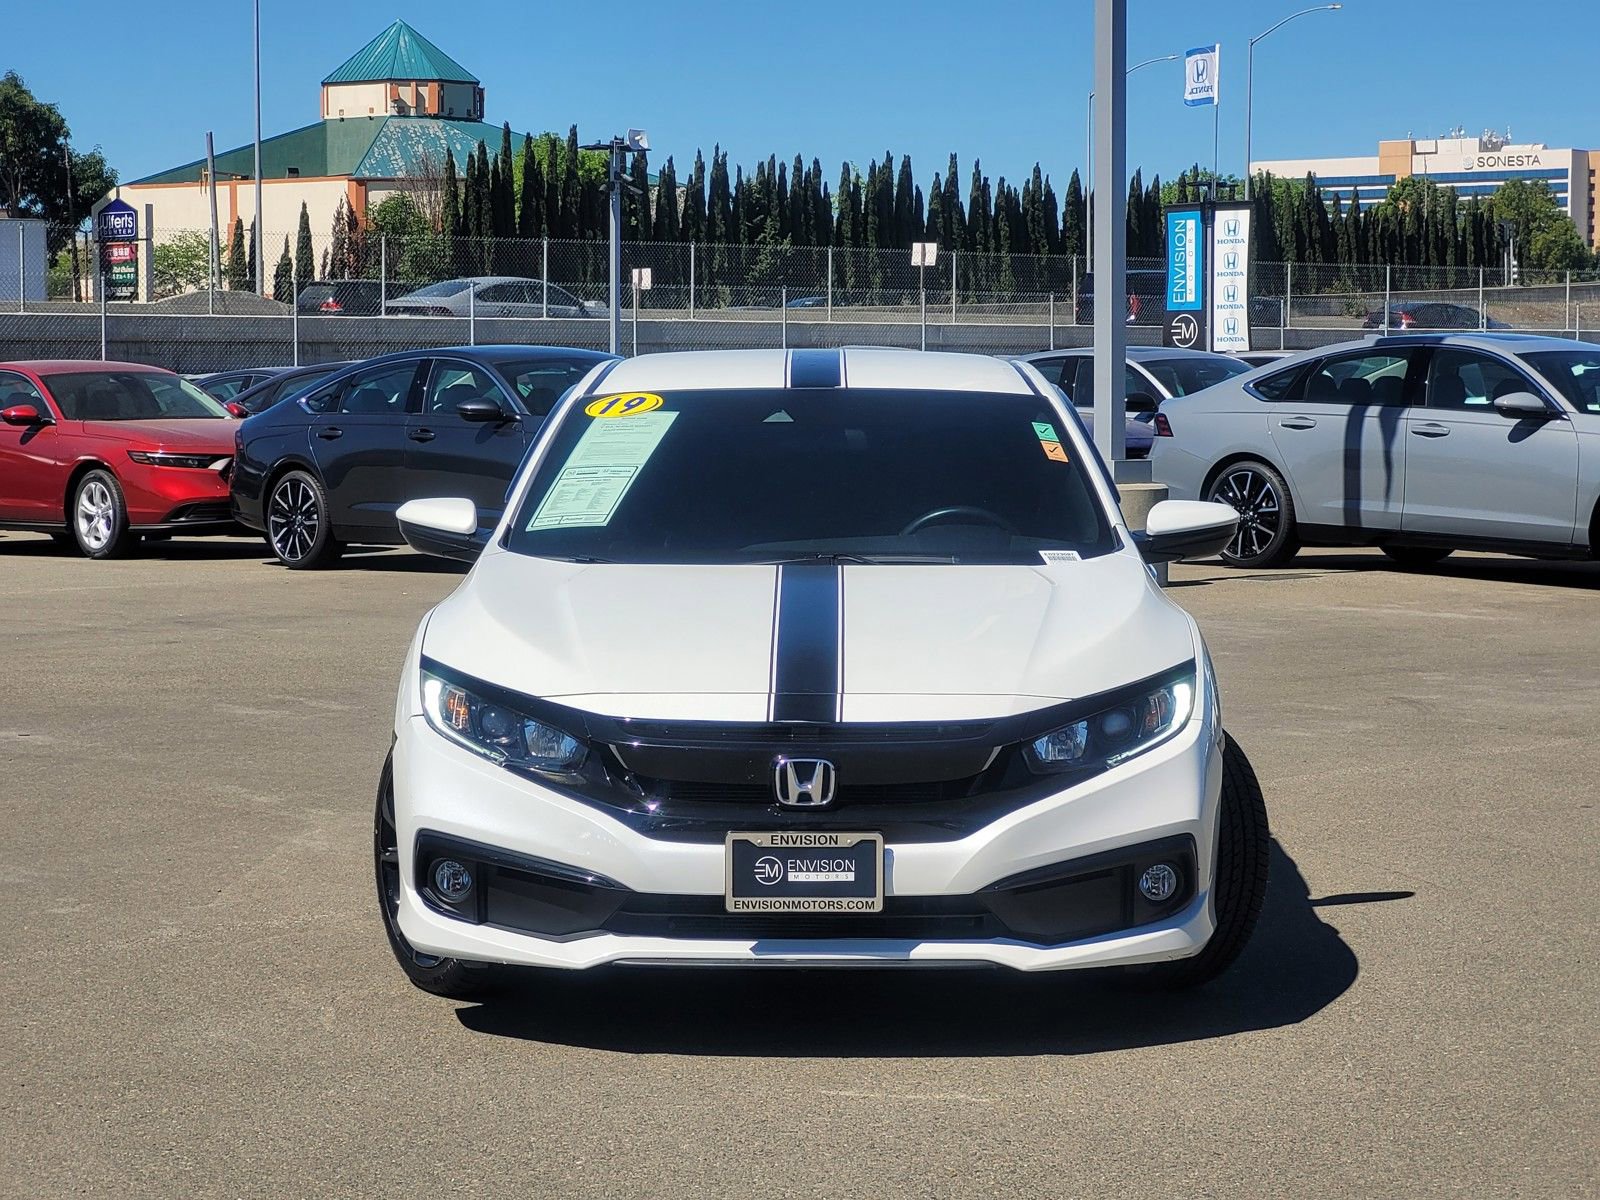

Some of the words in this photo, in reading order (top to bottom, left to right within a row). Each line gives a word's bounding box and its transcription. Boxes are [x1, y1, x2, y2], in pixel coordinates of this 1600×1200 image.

[1477, 154, 1541, 168] SONESTA
[102, 214, 133, 229] Ulferts
[1216, 237, 1246, 245] HONDA
[1173, 219, 1186, 303] ENVISION
[1216, 335, 1246, 343] HONDA
[599, 397, 647, 414] 19
[770, 834, 839, 846] ENVISION
[787, 859, 855, 872] ENVISION
[734, 900, 875, 910] ENVISIONMOTORS.COM
